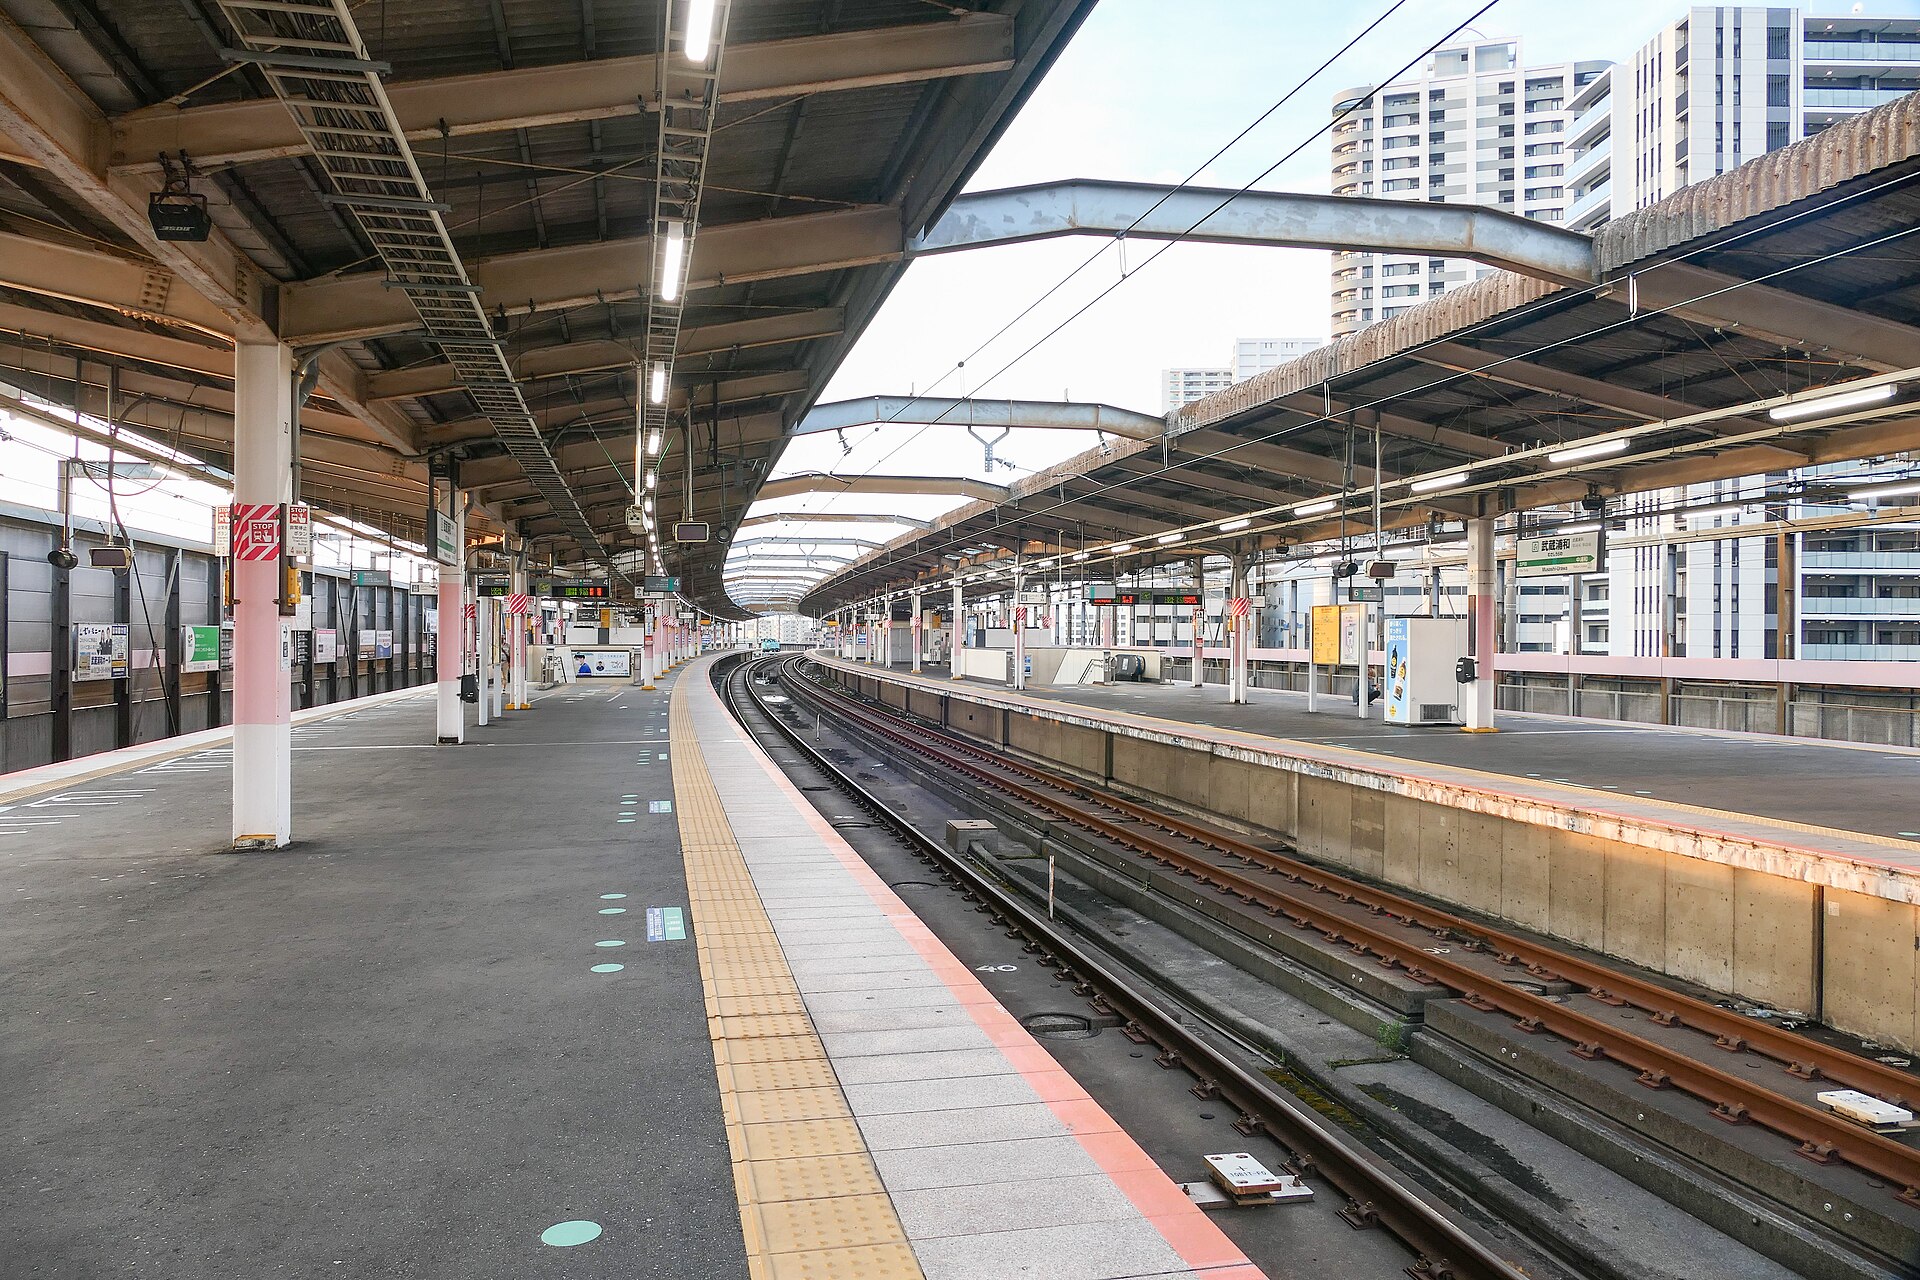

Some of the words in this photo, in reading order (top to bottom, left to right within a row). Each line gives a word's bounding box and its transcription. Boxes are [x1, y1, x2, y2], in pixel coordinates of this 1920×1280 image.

[1541, 538, 1571, 552] 武蔵浦和
[352, 572, 358, 580] 3
[674, 578, 680, 586] 4
[975, 964, 1018, 972] 40
